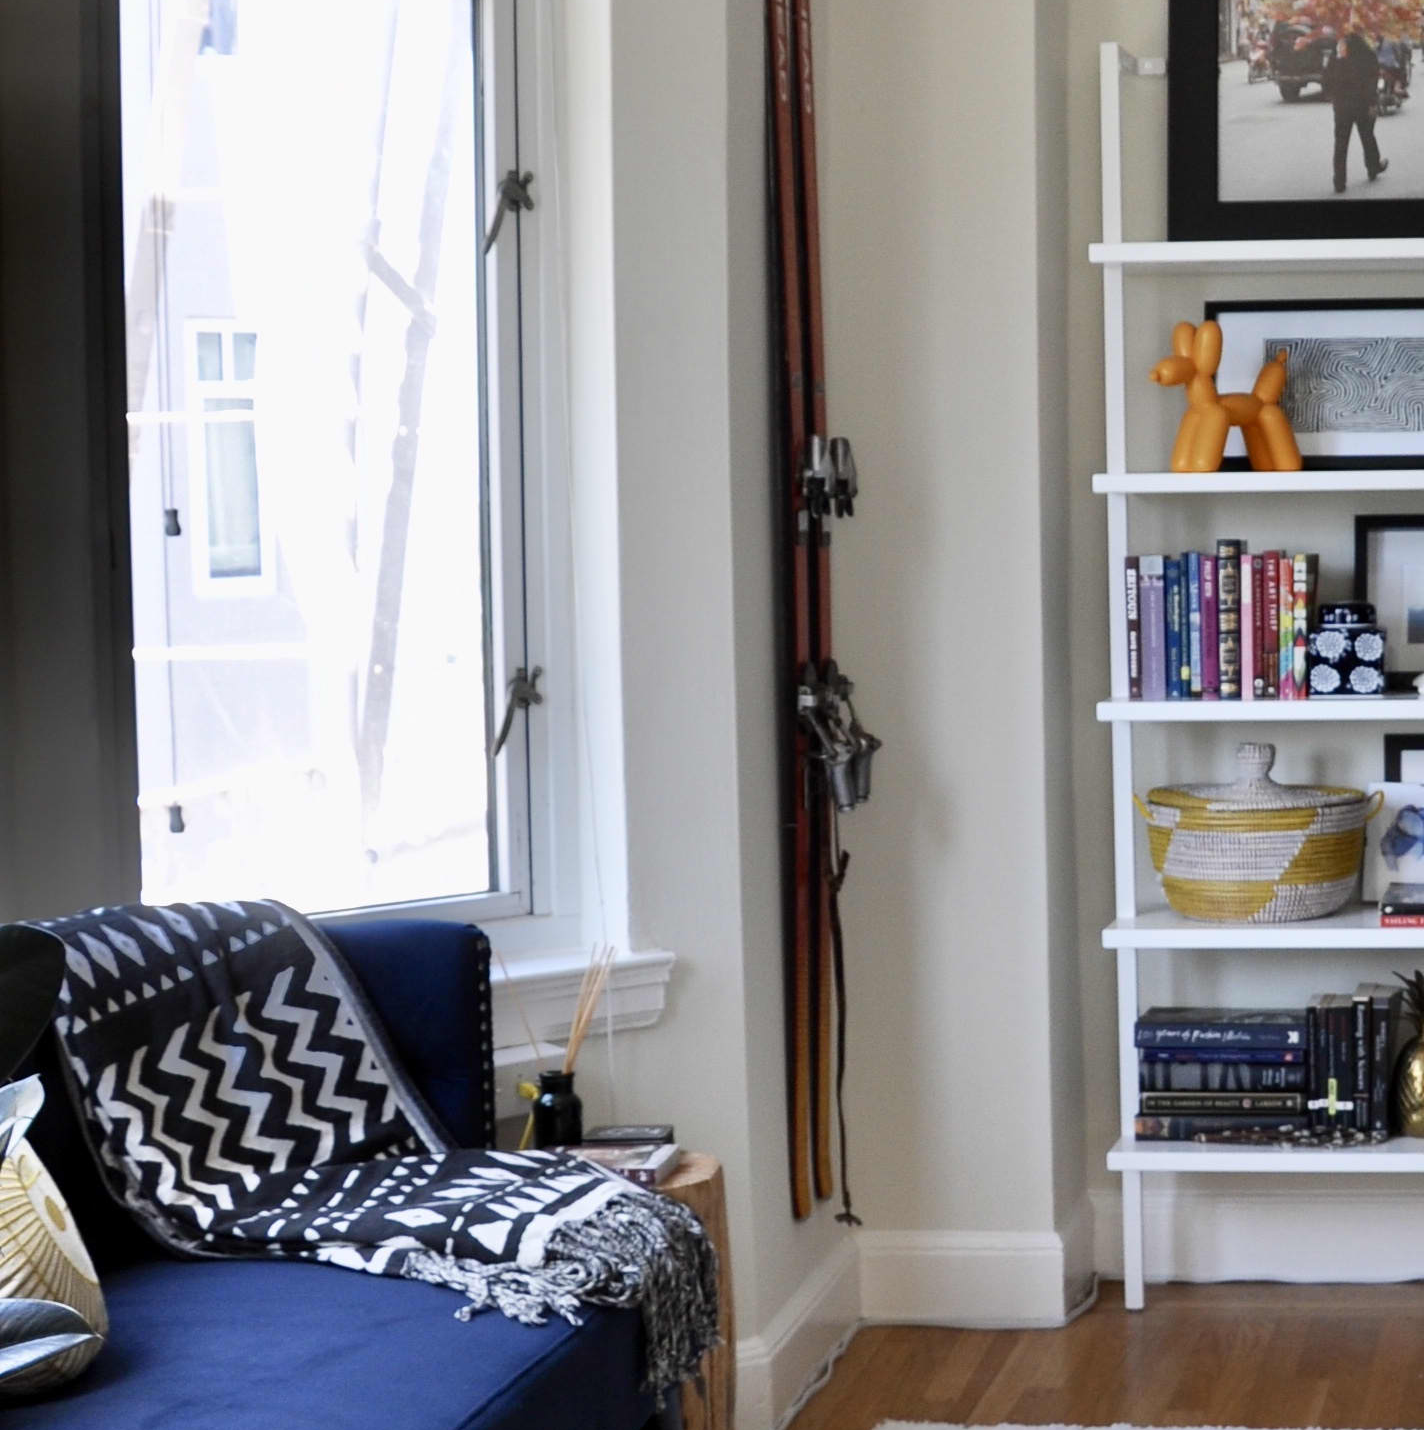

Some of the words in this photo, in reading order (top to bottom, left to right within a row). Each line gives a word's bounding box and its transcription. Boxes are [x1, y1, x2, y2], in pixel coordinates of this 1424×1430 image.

[1266, 559, 1275, 577] THE
[1126, 568, 1137, 620] ZEITOUN
[1267, 581, 1277, 600] ART
[1269, 603, 1278, 632] THIEF
